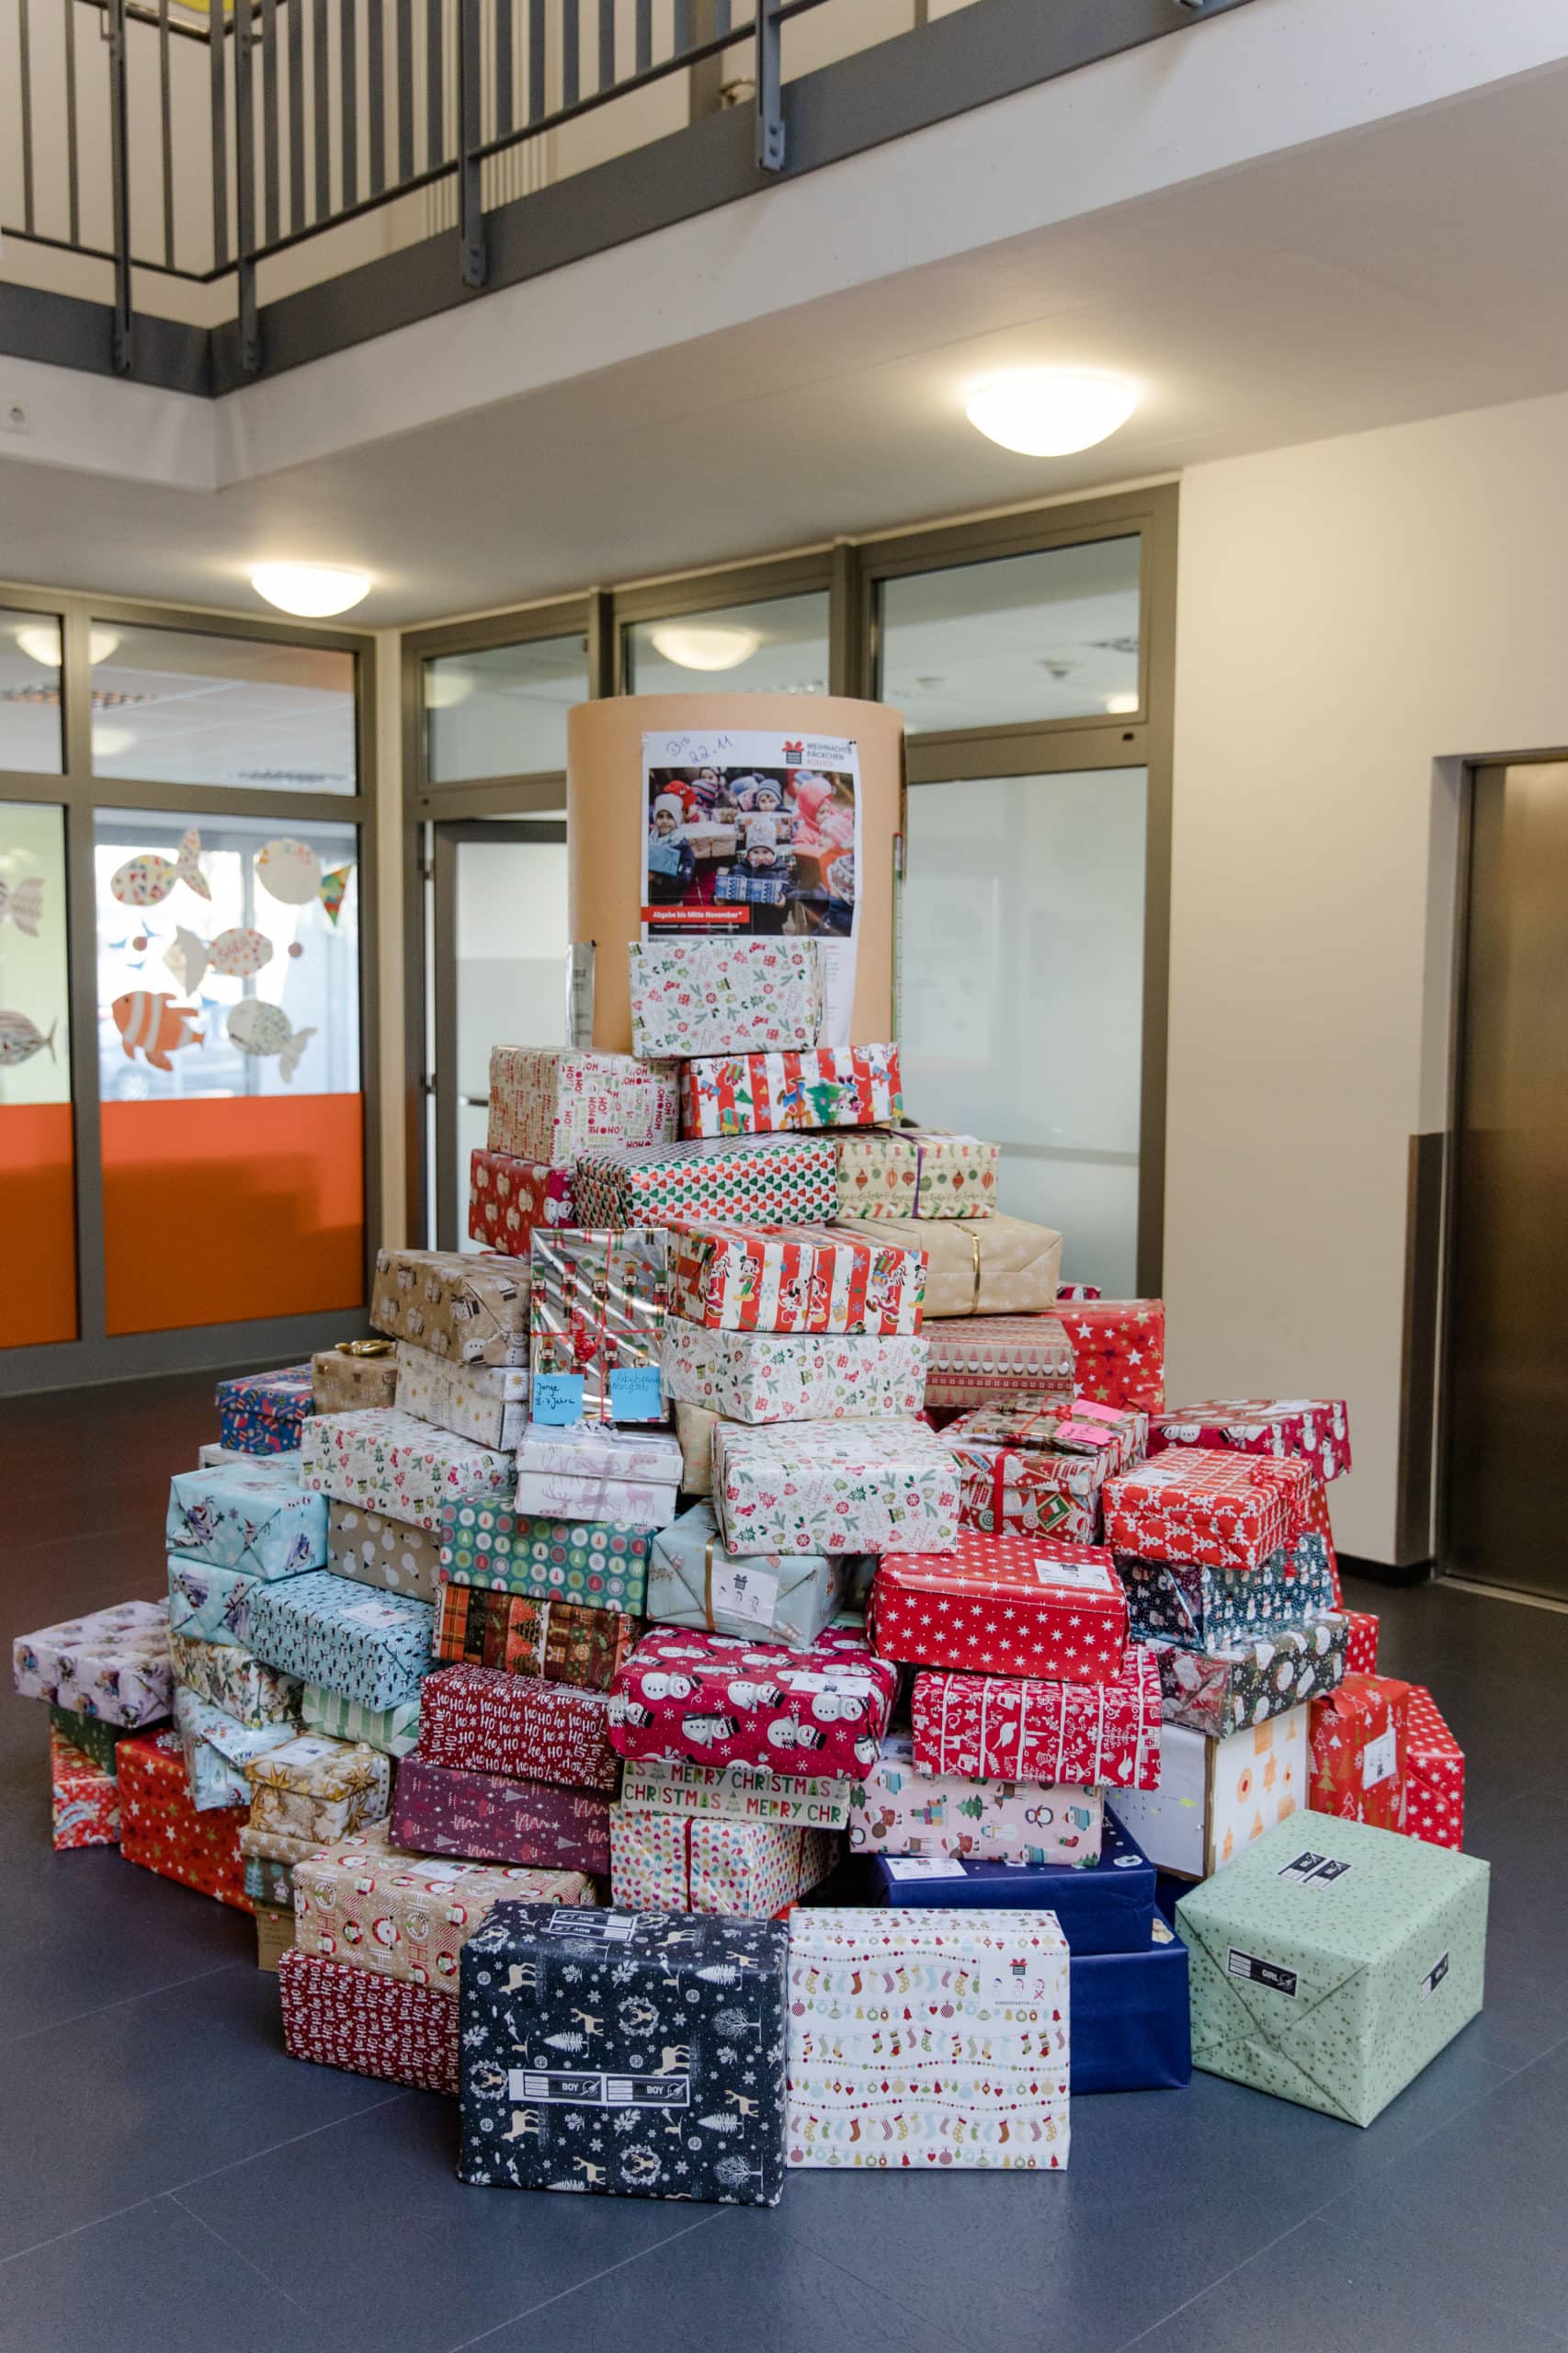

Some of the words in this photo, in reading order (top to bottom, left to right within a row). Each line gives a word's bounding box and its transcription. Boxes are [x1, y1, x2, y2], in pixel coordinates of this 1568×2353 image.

[537, 1382, 559, 1396] Junge
[671, 1766, 726, 1786] MERRY
[731, 1770, 830, 1797] CHRISTMAS
[624, 1783, 722, 1809] CHRISTMAS
[746, 1798, 802, 1818] MERRY
[807, 1804, 841, 1823] CHR
[562, 2082, 579, 2092] BOY
[646, 2086, 664, 2095] BOY
